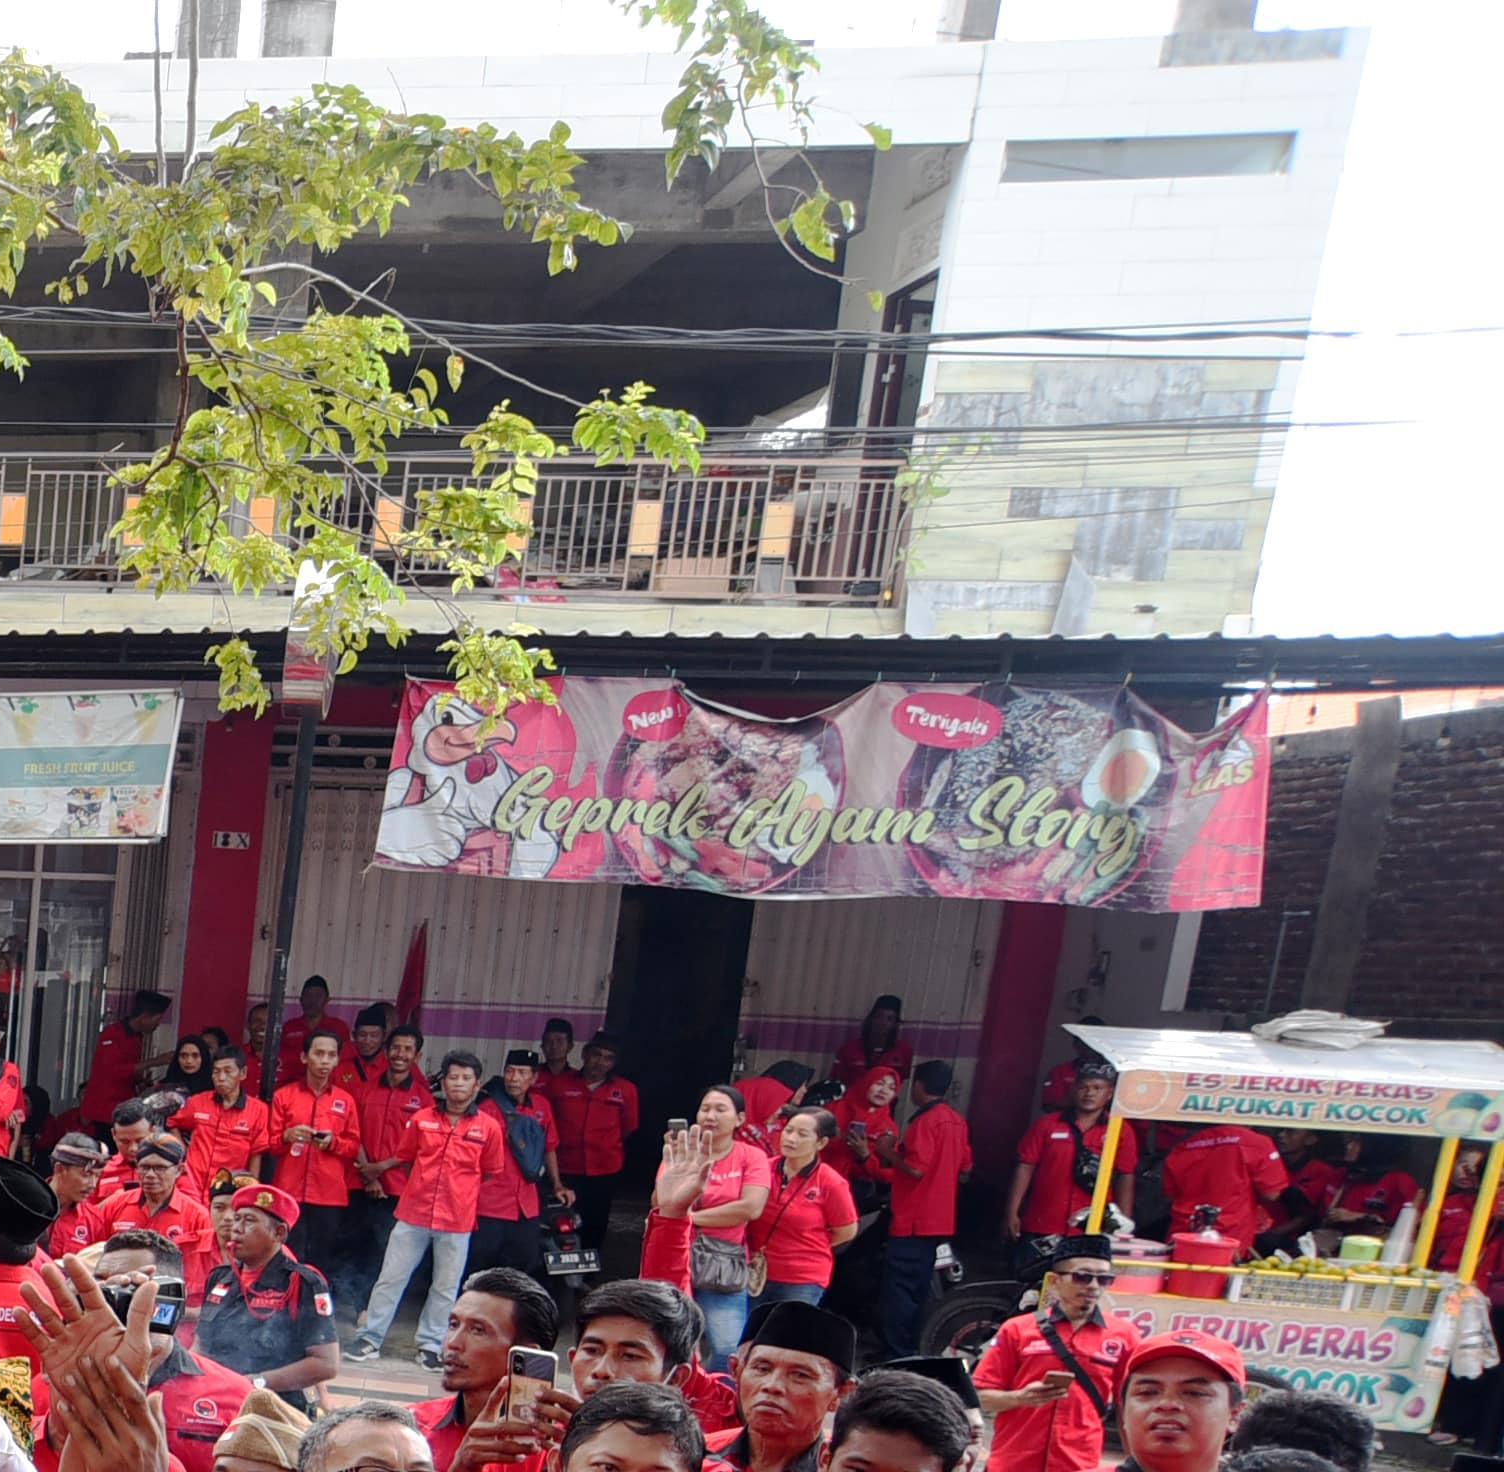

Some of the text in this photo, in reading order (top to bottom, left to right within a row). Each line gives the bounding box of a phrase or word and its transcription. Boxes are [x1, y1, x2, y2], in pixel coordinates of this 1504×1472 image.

[906, 705, 990, 738] Teriyaki
[23, 759, 136, 775] FRESH FRUIT JUICE
[495, 763, 1137, 877] Geprek Ayam Story
[1185, 1072, 1435, 1102] ES JERUK PERAS
[1180, 1094, 1428, 1125] ALPUKAT KOCOK
[1276, 1324, 1394, 1363] PERAS
